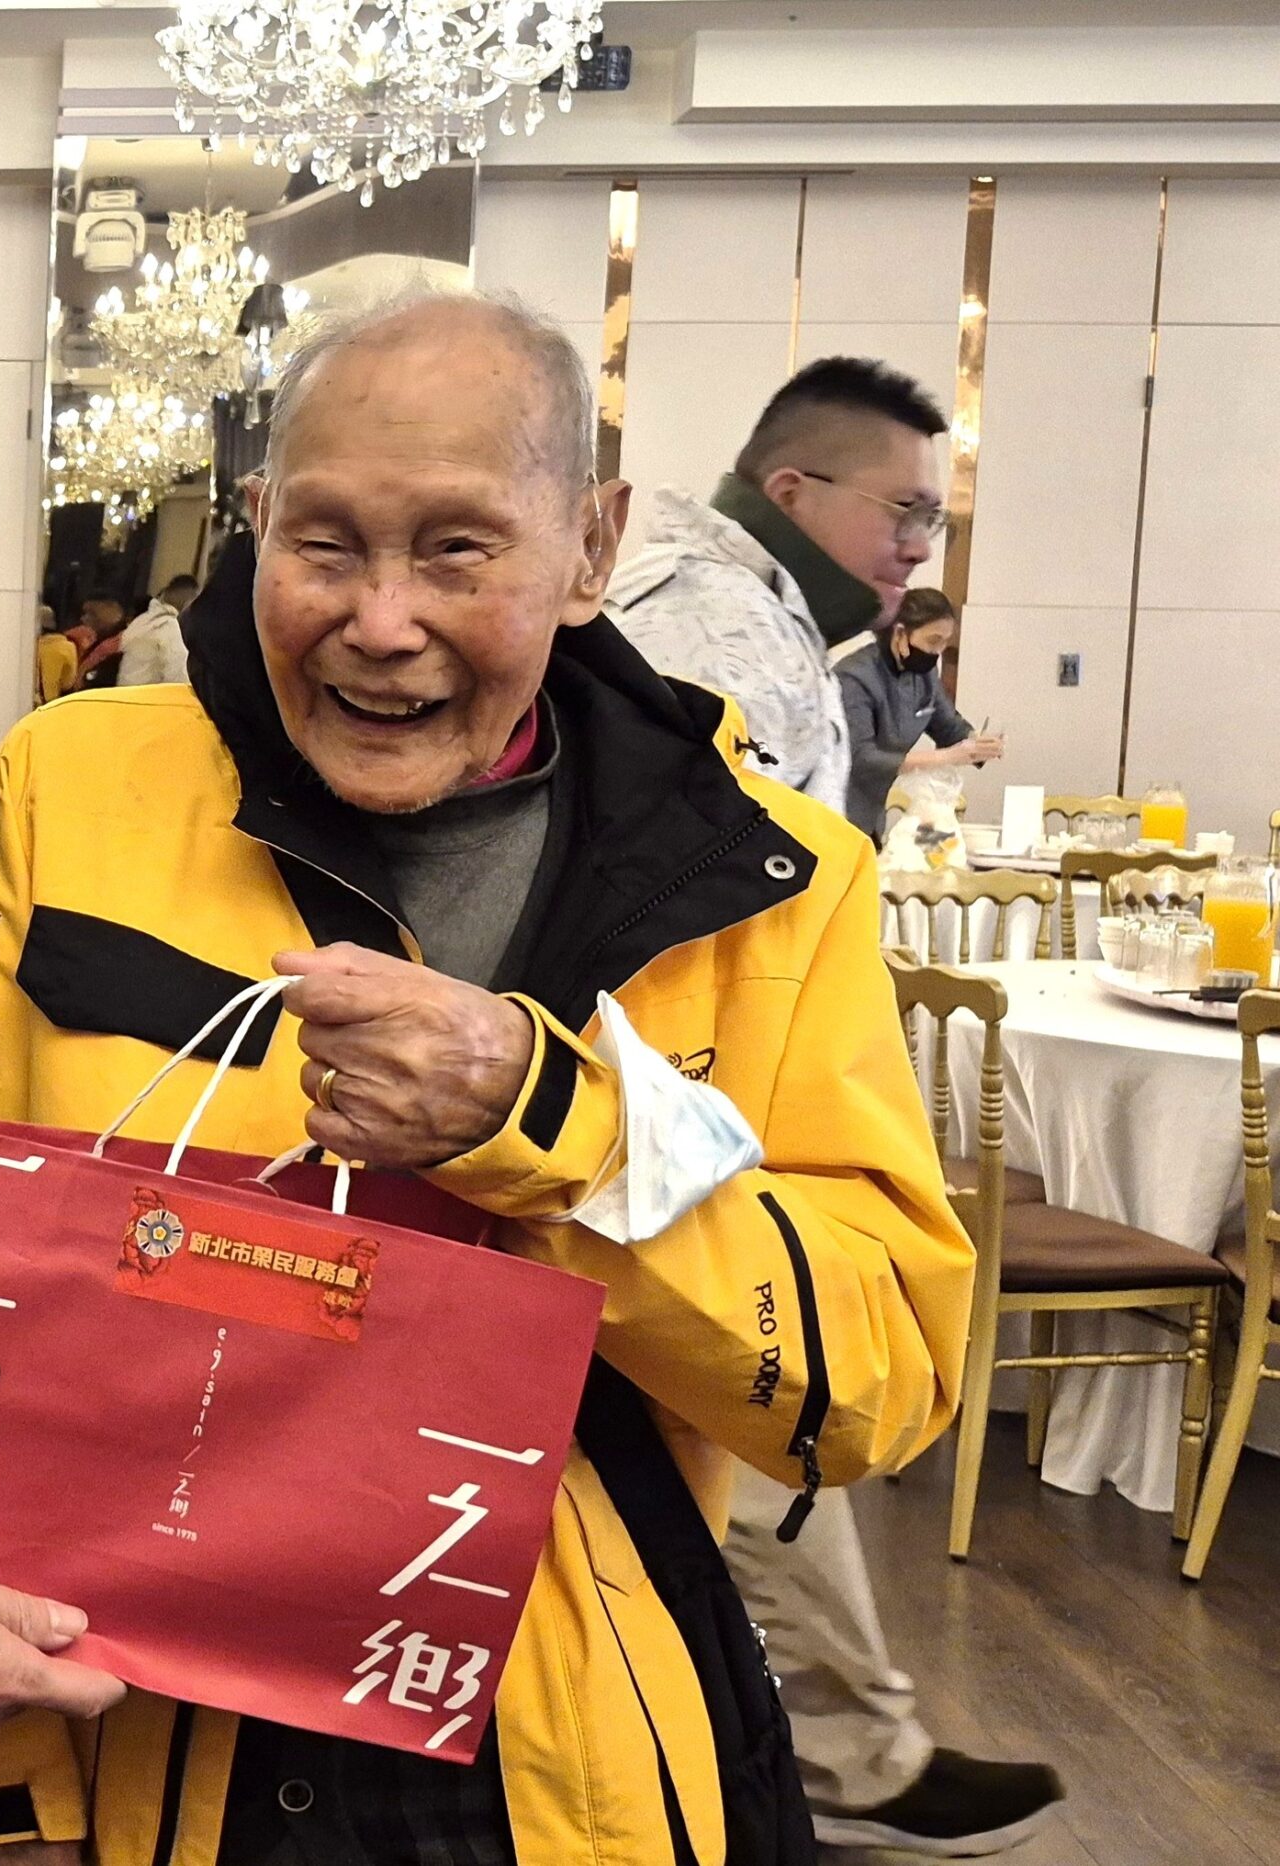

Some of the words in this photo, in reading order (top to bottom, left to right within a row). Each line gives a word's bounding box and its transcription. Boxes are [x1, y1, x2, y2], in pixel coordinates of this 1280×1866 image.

[754, 1280, 778, 1336] PRO
[747, 1344, 782, 1409] DORMY
[151, 1521, 175, 1536] since
[343, 1428, 544, 1749] 一之鄉
